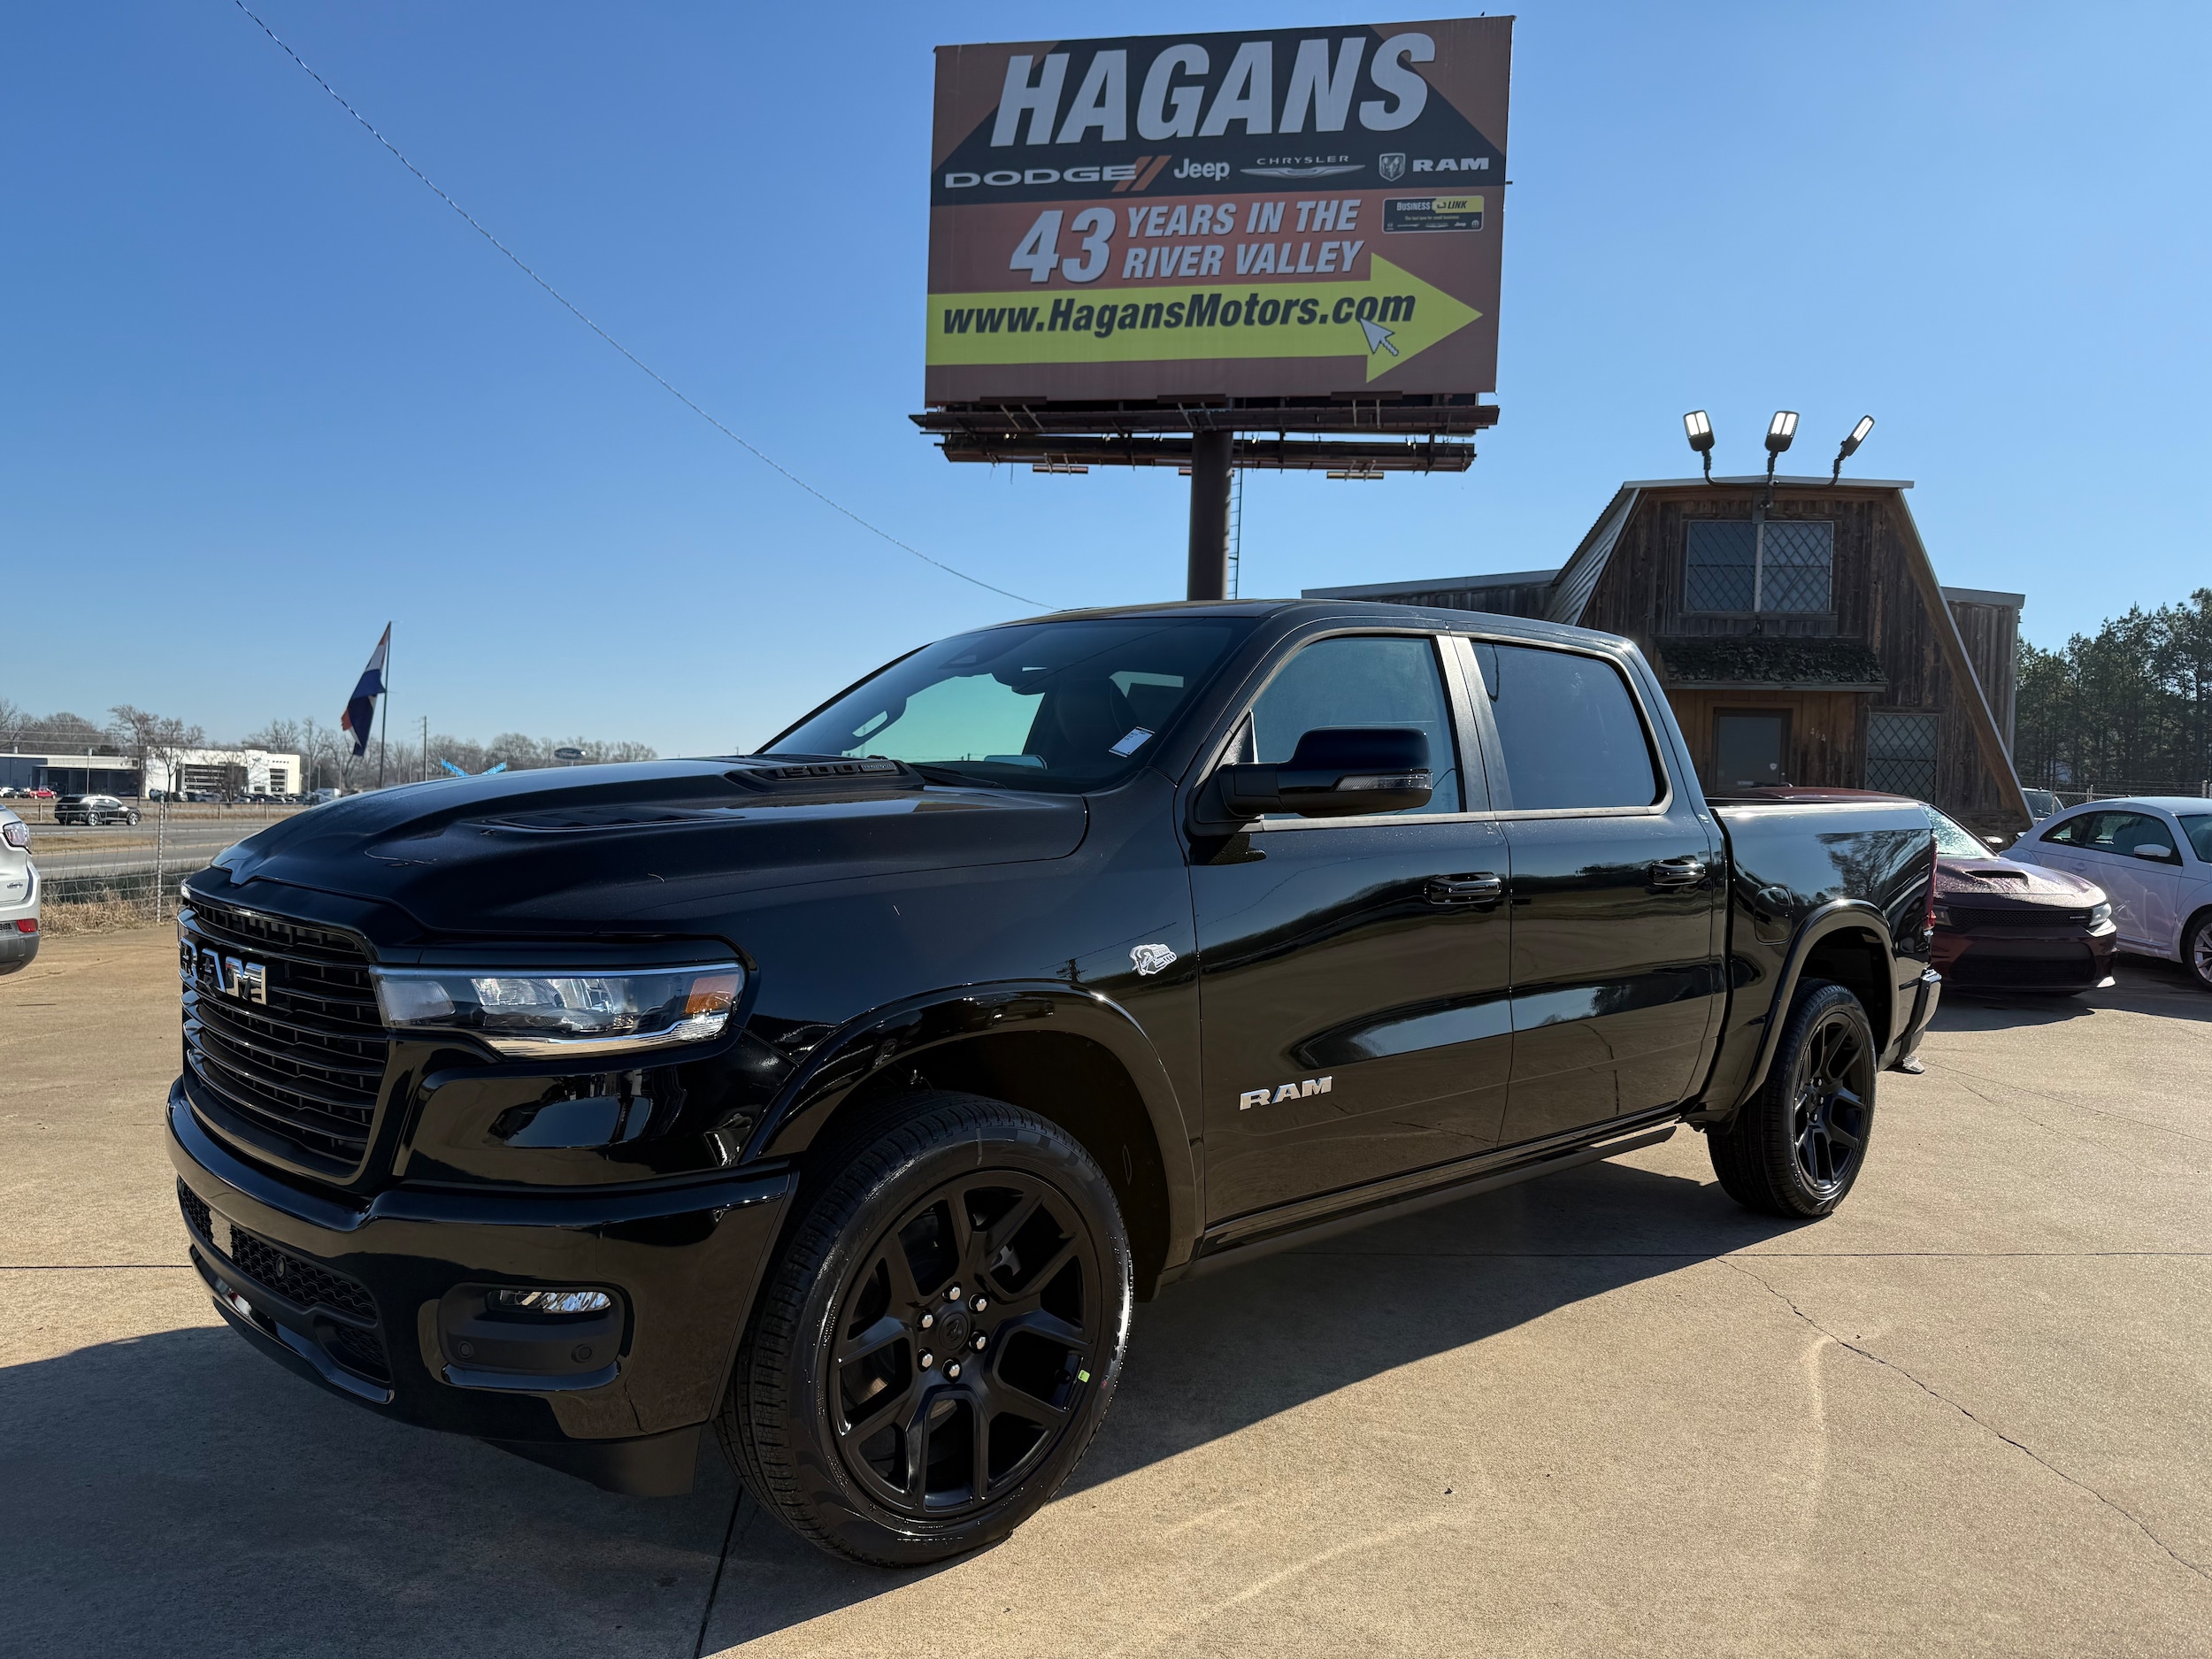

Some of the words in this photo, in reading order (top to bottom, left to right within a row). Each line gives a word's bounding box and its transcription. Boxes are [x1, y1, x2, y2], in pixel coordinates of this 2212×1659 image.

[990, 33, 1436, 147] HAGANS
[945, 165, 1137, 188] DODGE
[1173, 158, 1230, 181] Jeep
[1256, 155, 1349, 165] CHRYSLER
[1412, 157, 1490, 172] RAM
[1127, 203, 1238, 238] YEARS
[1246, 202, 1286, 234] IN
[1296, 199, 1363, 232] THE
[1448, 200, 1468, 210] LINK
[1010, 207, 1117, 283] 43
[1122, 244, 1225, 279] RIVER
[1235, 240, 1365, 275] VALLEY
[943, 293, 1416, 338] www.HagansMotors.com
[180, 936, 267, 1006] RAM
[1240, 1076, 1333, 1110] RAM
